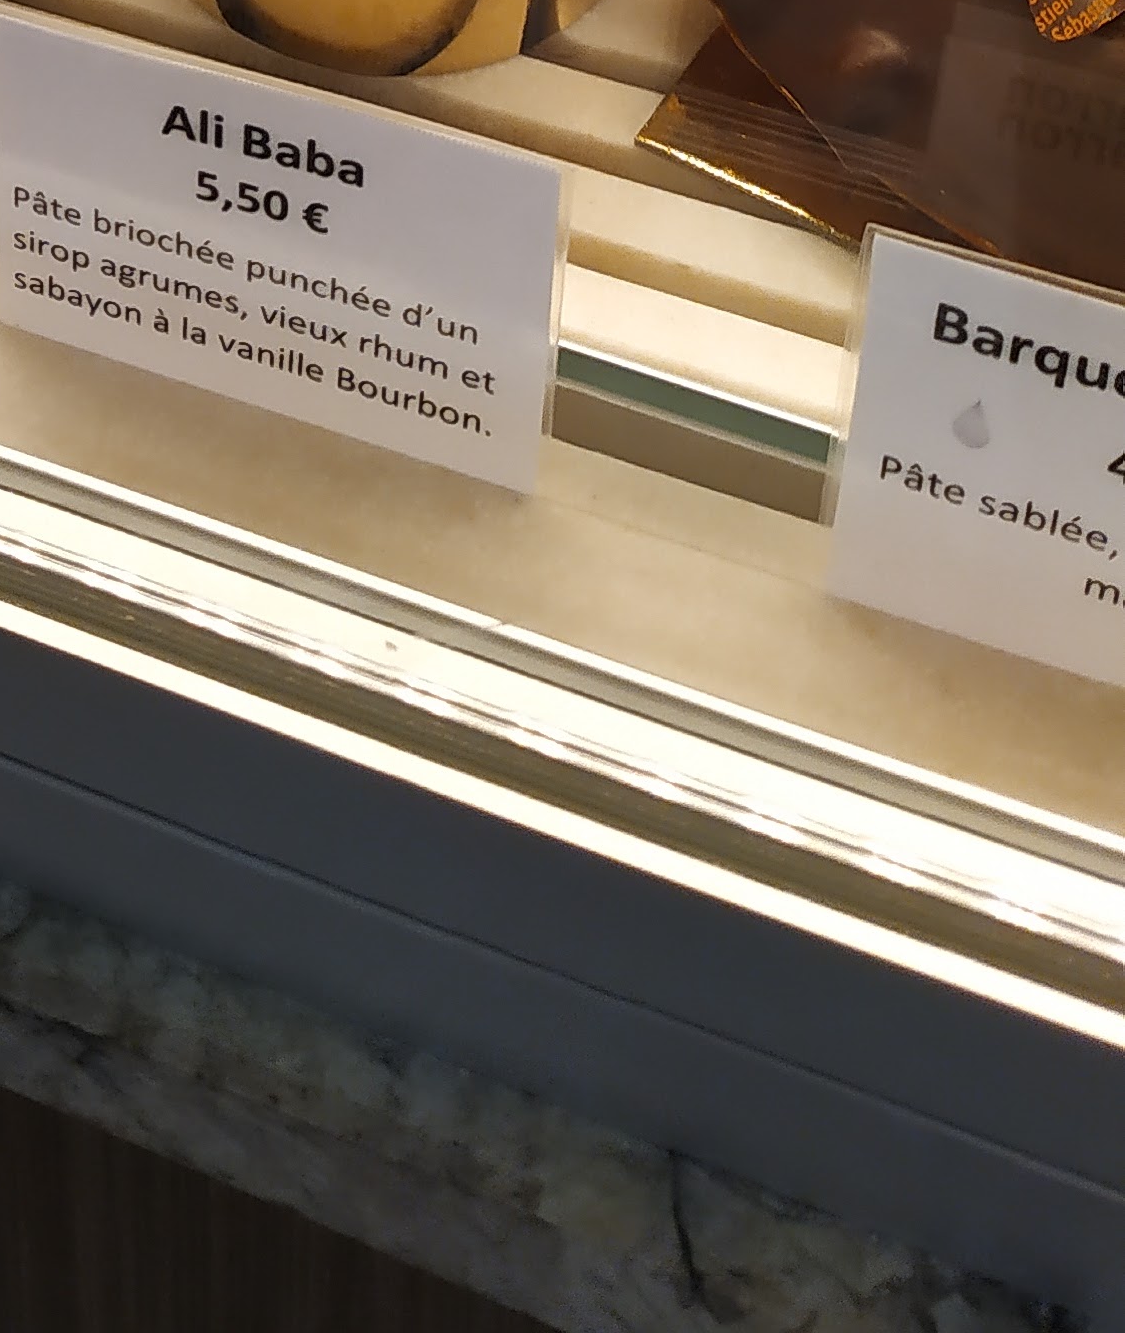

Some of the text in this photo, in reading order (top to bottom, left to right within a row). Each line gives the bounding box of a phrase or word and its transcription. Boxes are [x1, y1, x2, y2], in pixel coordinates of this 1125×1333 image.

[161, 104, 365, 187] Ali Baba
[195, 171, 330, 235] 5,50 €
[13, 186, 82, 227] Pâte
[93, 208, 234, 271] briochée
[246, 257, 391, 320] punchée
[13, 230, 495, 396] sirop agrumes, vieux rhum et
[13, 270, 492, 437] sabayon à la vanille Bourbon.
[880, 454, 1118, 561] Pâte sablée,
